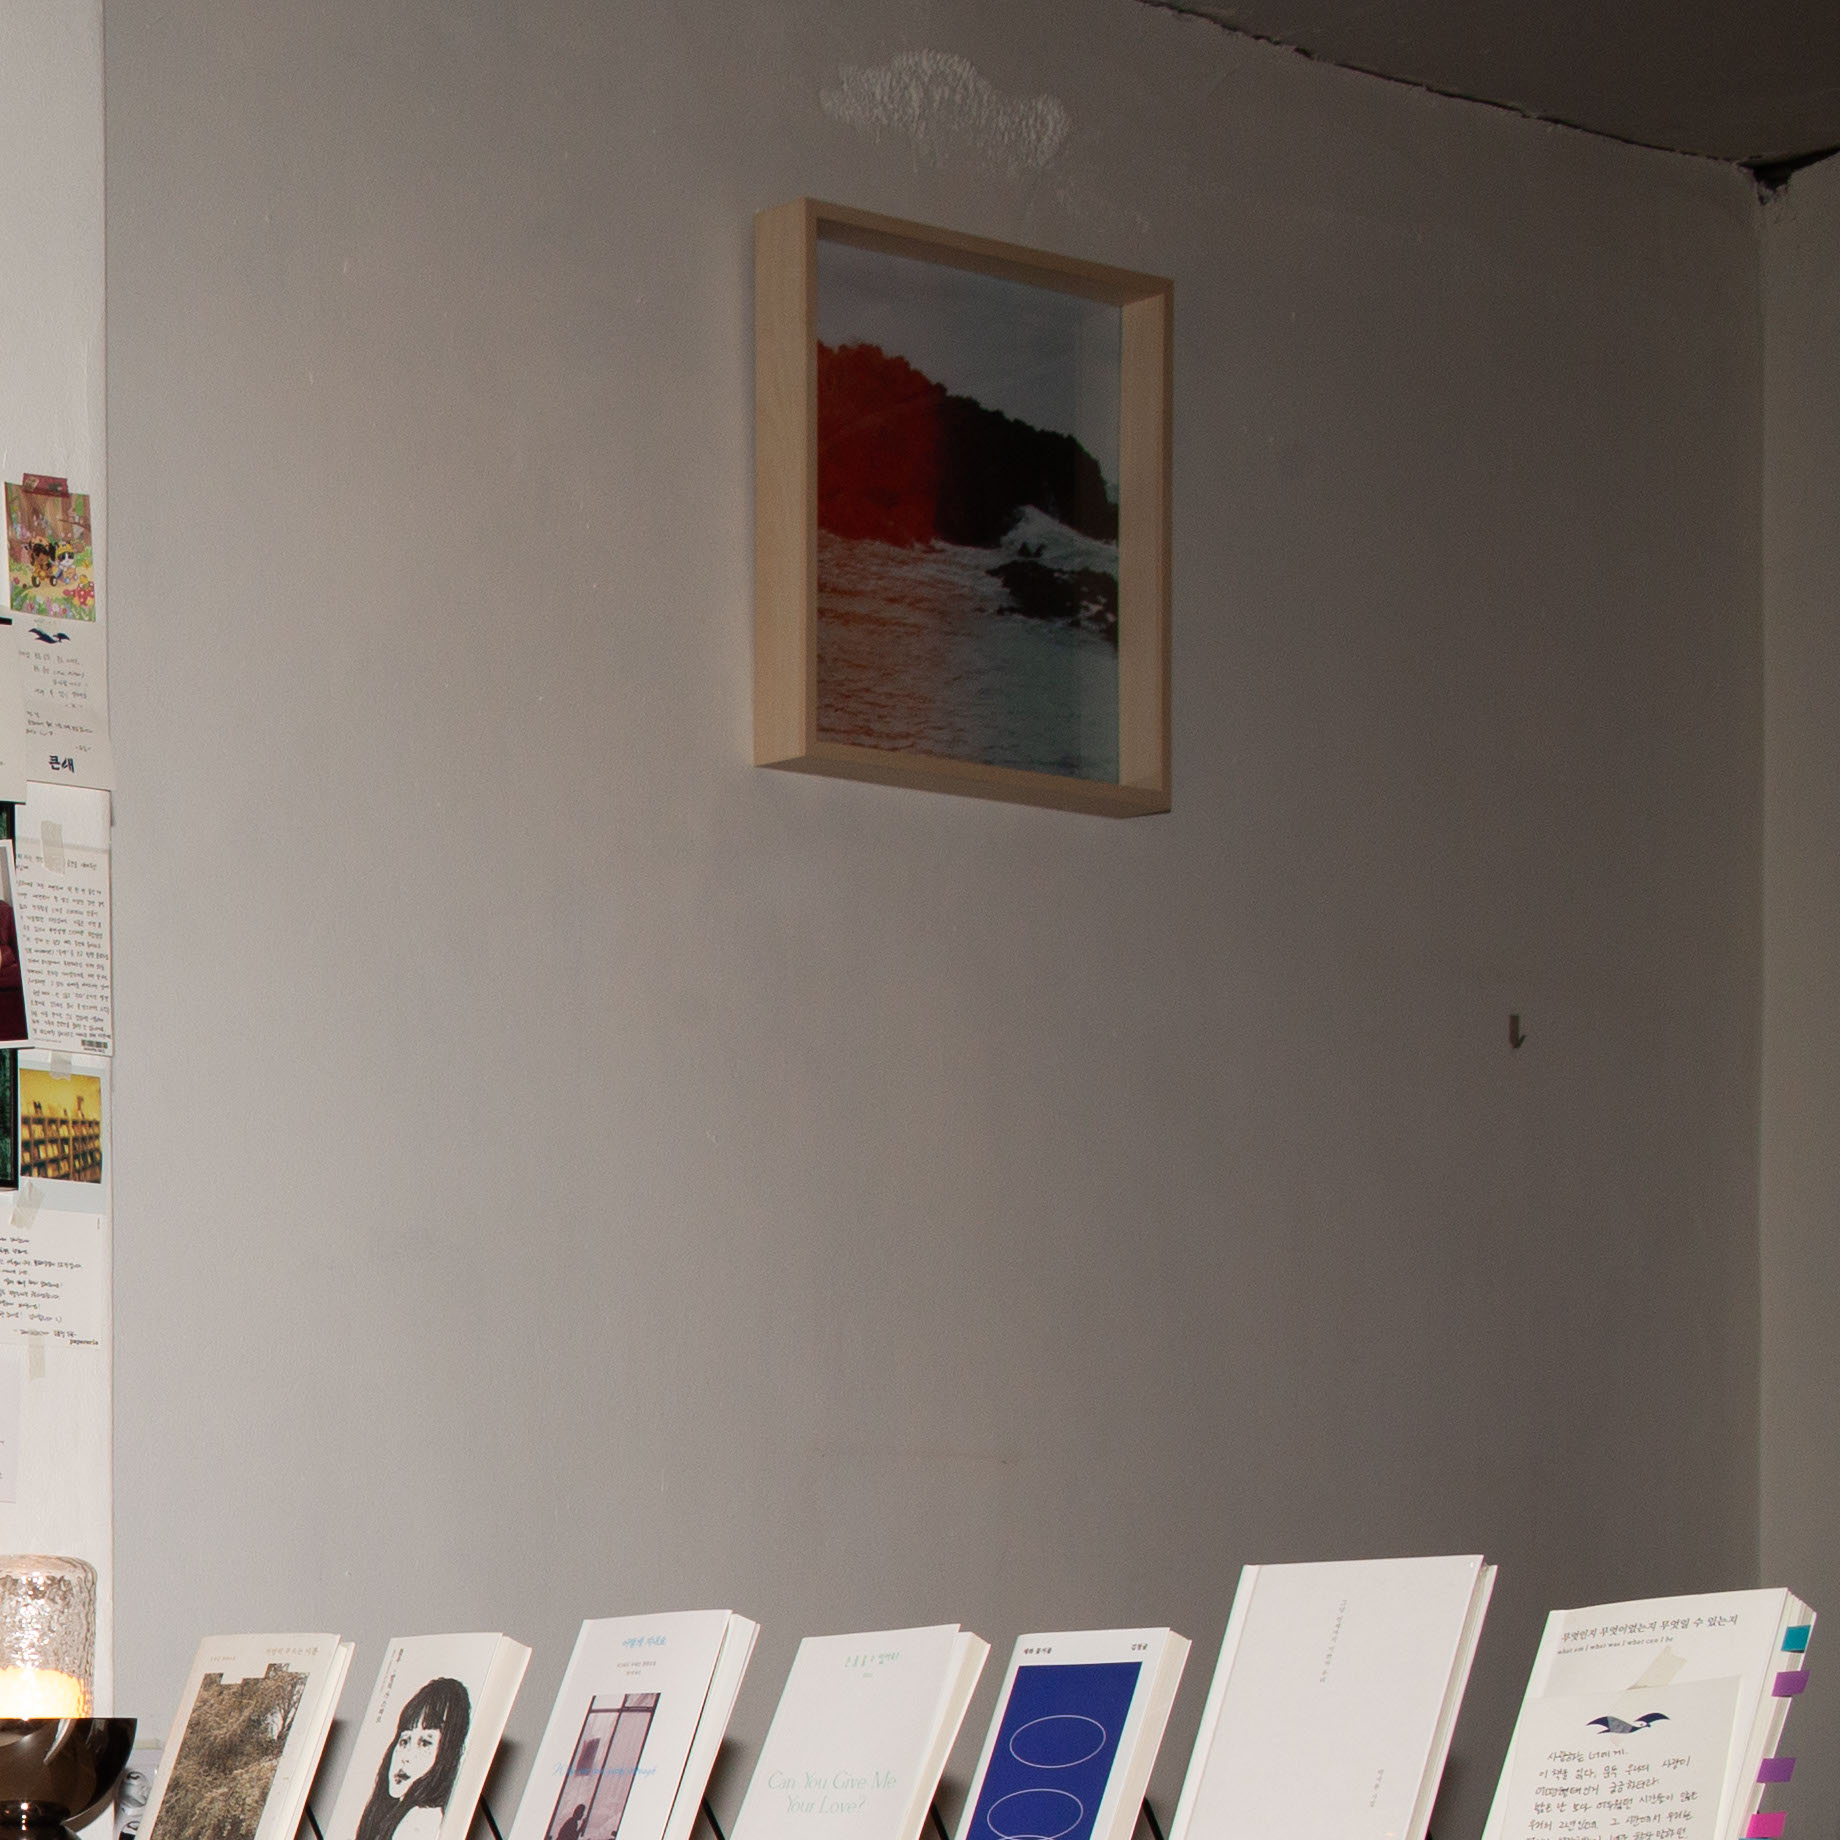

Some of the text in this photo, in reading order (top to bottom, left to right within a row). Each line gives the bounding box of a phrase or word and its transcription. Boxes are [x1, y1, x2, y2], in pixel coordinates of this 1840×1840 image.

[49, 754, 75, 773] 큰새
[1693, 1617, 1704, 1628] 수
[1708, 1614, 1738, 1627] 있는지
[768, 1770, 897, 1790] Can You Give Me
[786, 1794, 866, 1814] Your Love?
